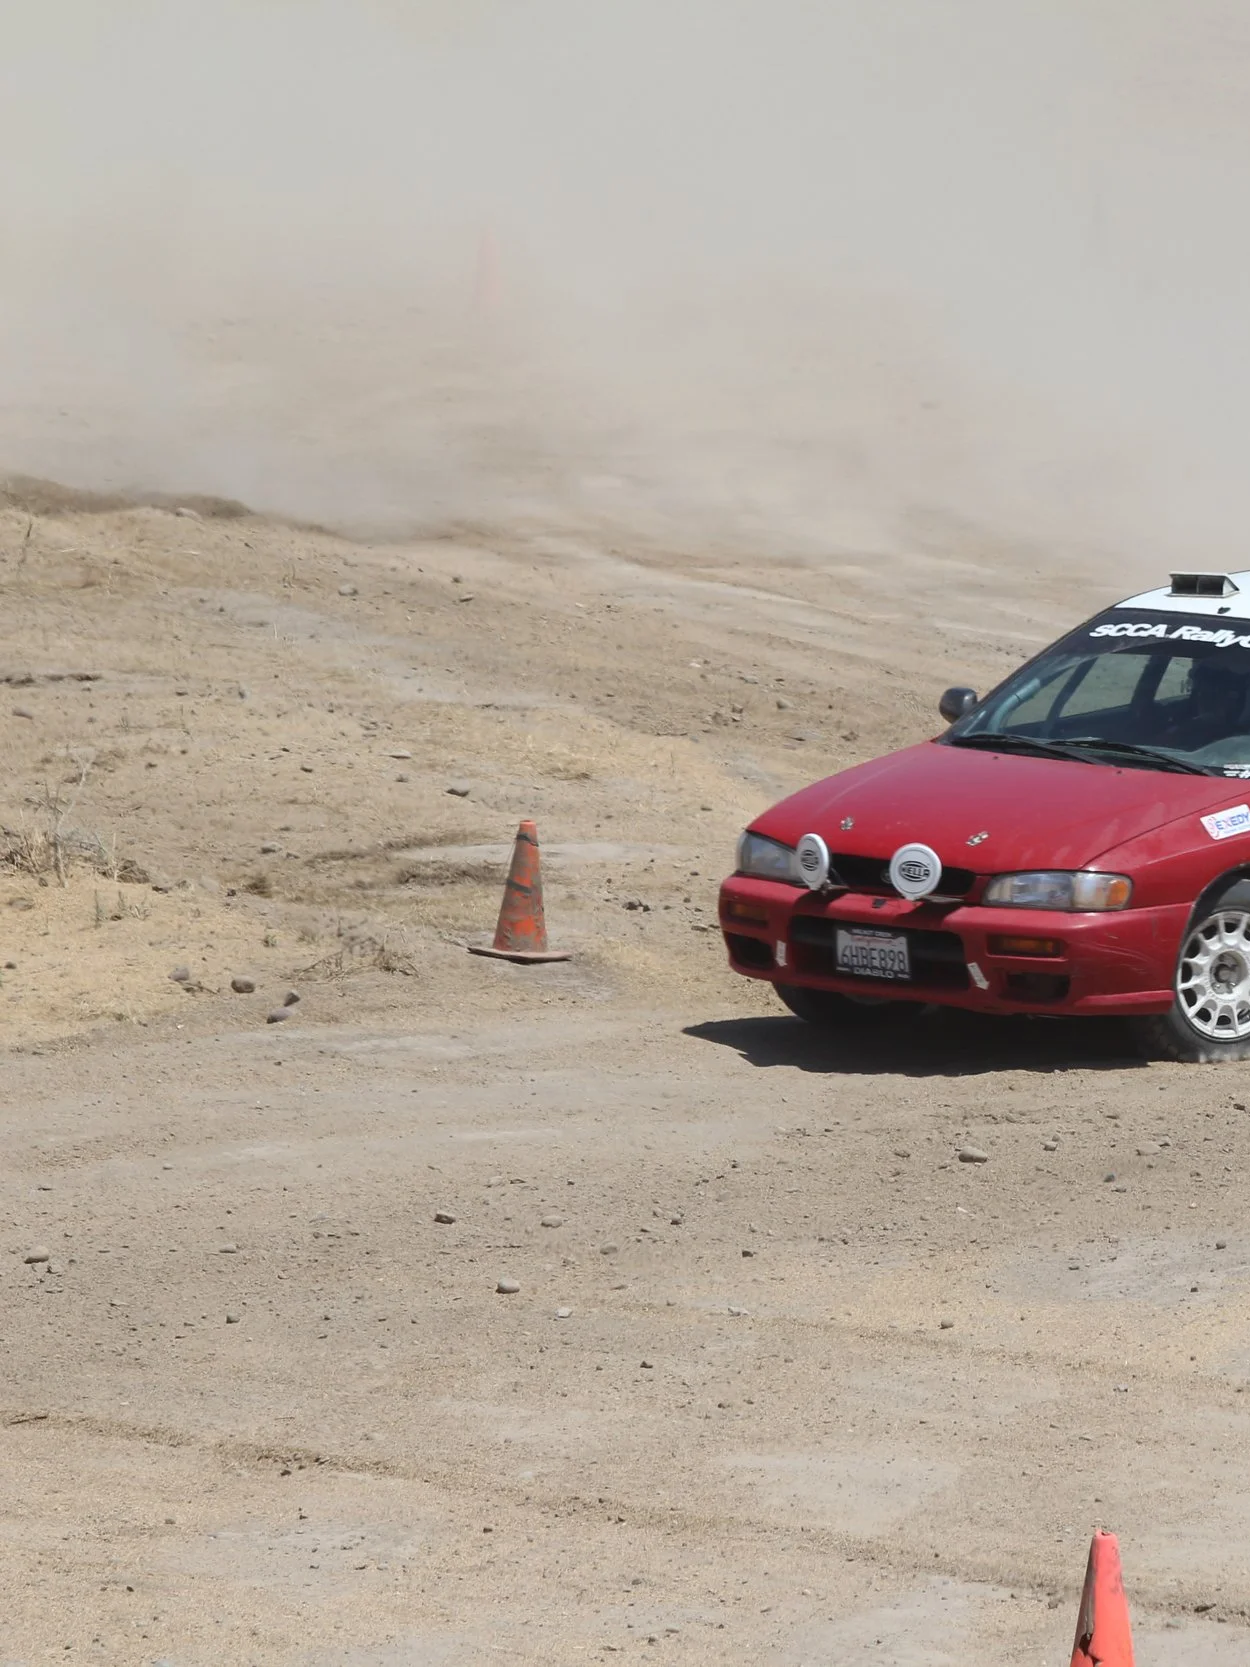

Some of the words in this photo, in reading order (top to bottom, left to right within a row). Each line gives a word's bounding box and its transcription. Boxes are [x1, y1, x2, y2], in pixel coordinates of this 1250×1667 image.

[1215, 812, 1249, 830] EXEDY
[901, 866, 931, 878] HELLA
[853, 967, 895, 979] DIABLO
